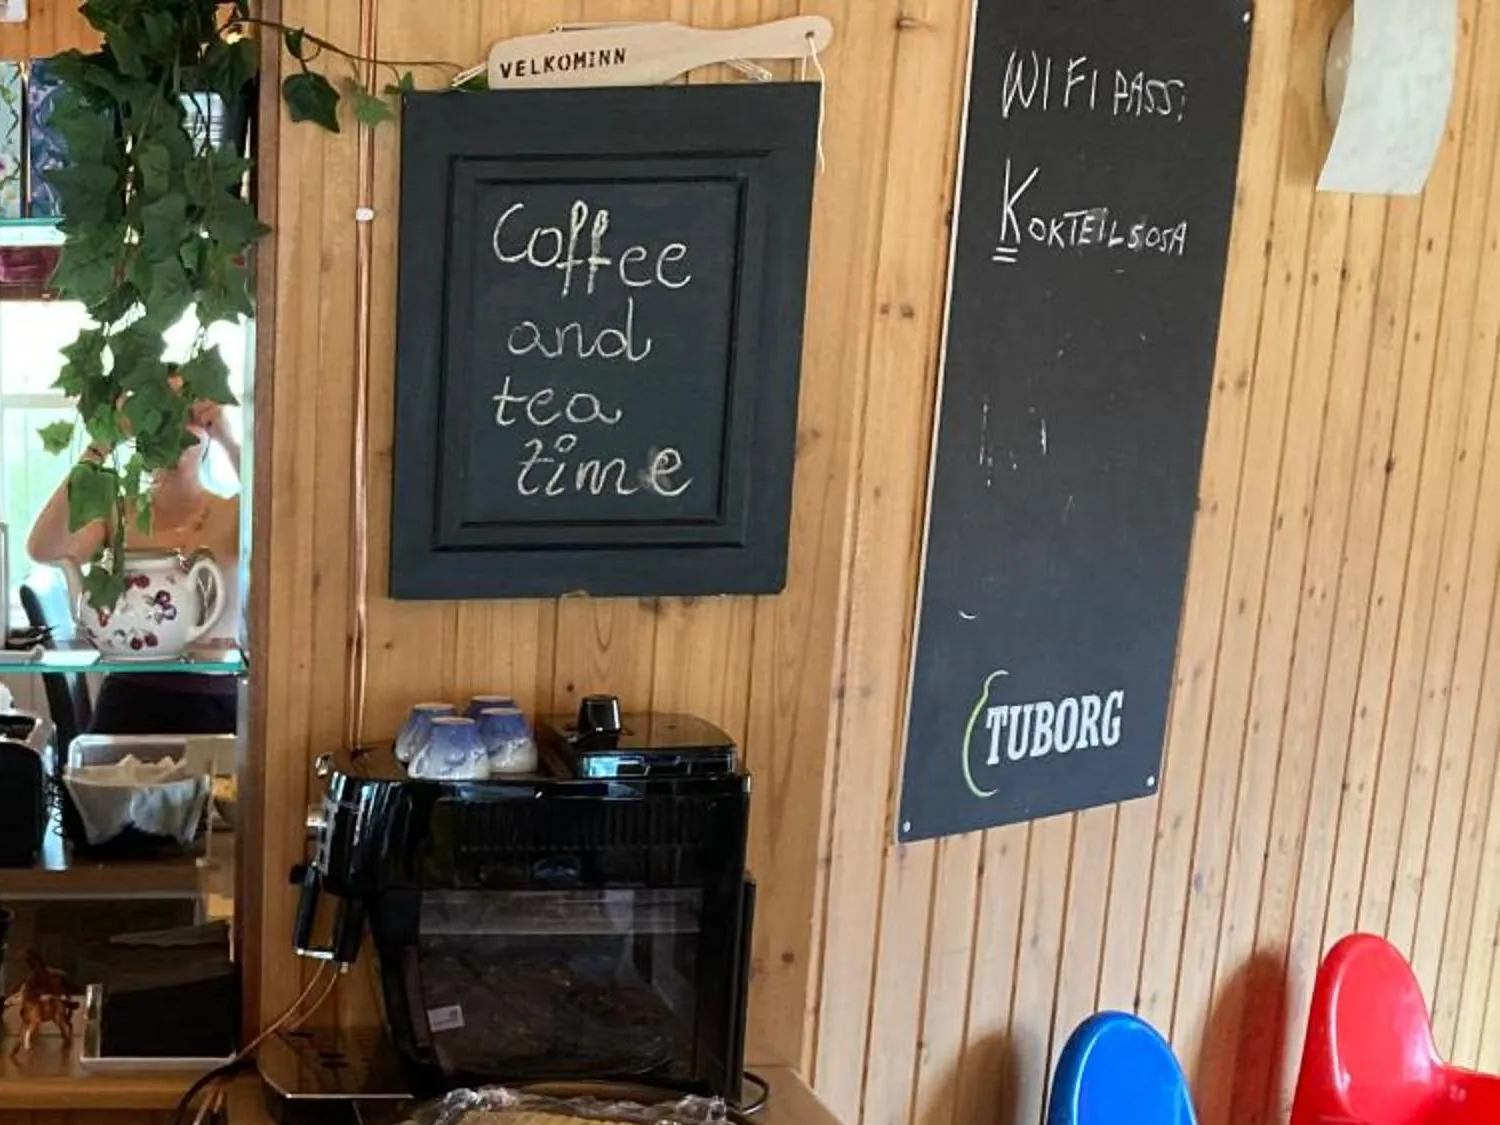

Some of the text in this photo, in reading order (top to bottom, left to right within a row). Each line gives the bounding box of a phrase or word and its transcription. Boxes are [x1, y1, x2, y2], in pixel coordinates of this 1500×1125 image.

[500, 47, 626, 79] VELKOMINN
[492, 200, 692, 296] Coffee
[507, 297, 652, 362] and
[492, 375, 623, 427] tea
[516, 433, 694, 497] time
[984, 689, 1125, 767] TUBORG
